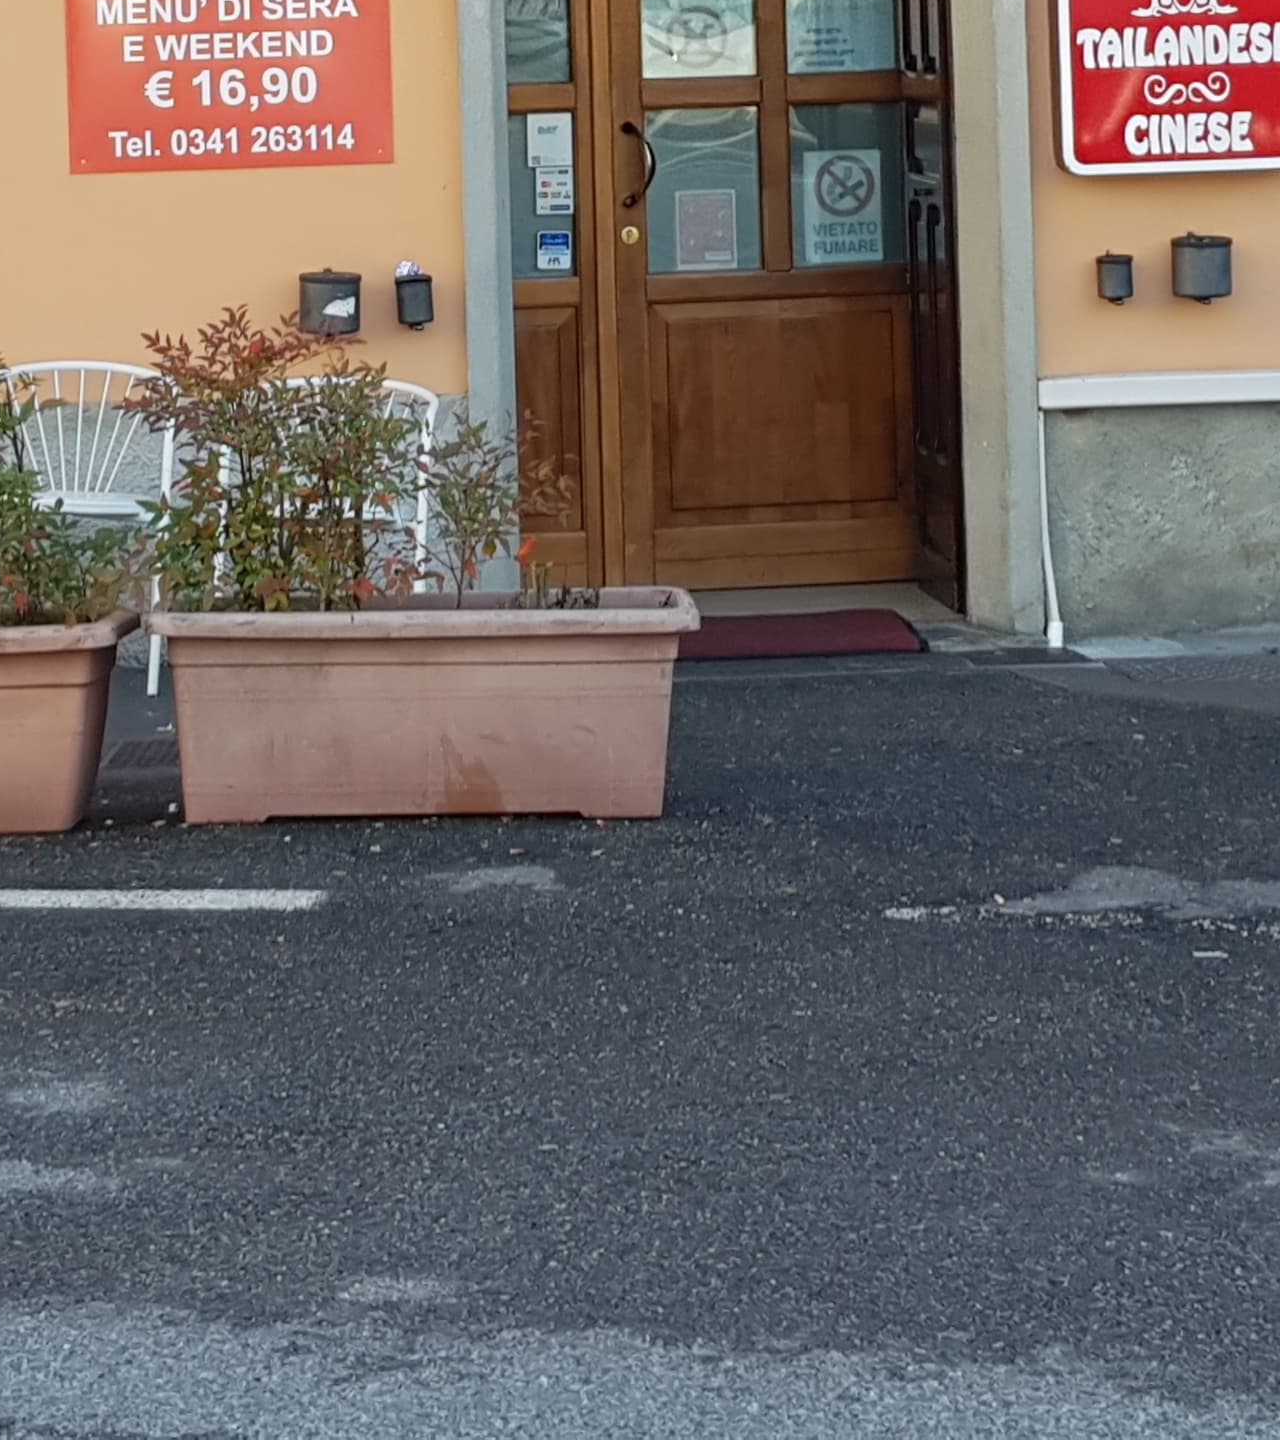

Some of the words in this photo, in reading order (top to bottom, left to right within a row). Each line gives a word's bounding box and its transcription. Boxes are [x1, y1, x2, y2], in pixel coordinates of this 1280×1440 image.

[123, 36, 145, 62] E
[155, 29, 334, 61] WEEKEND
[144, 70, 174, 108] €
[191, 66, 317, 112] 16,90
[108, 130, 161, 158] Tel.
[171, 127, 239, 156] 0341
[251, 123, 355, 153] 263114
[1124, 111, 1254, 156] CINESE
[813, 221, 878, 237] VIETATO
[813, 238, 879, 256] FUMARE
